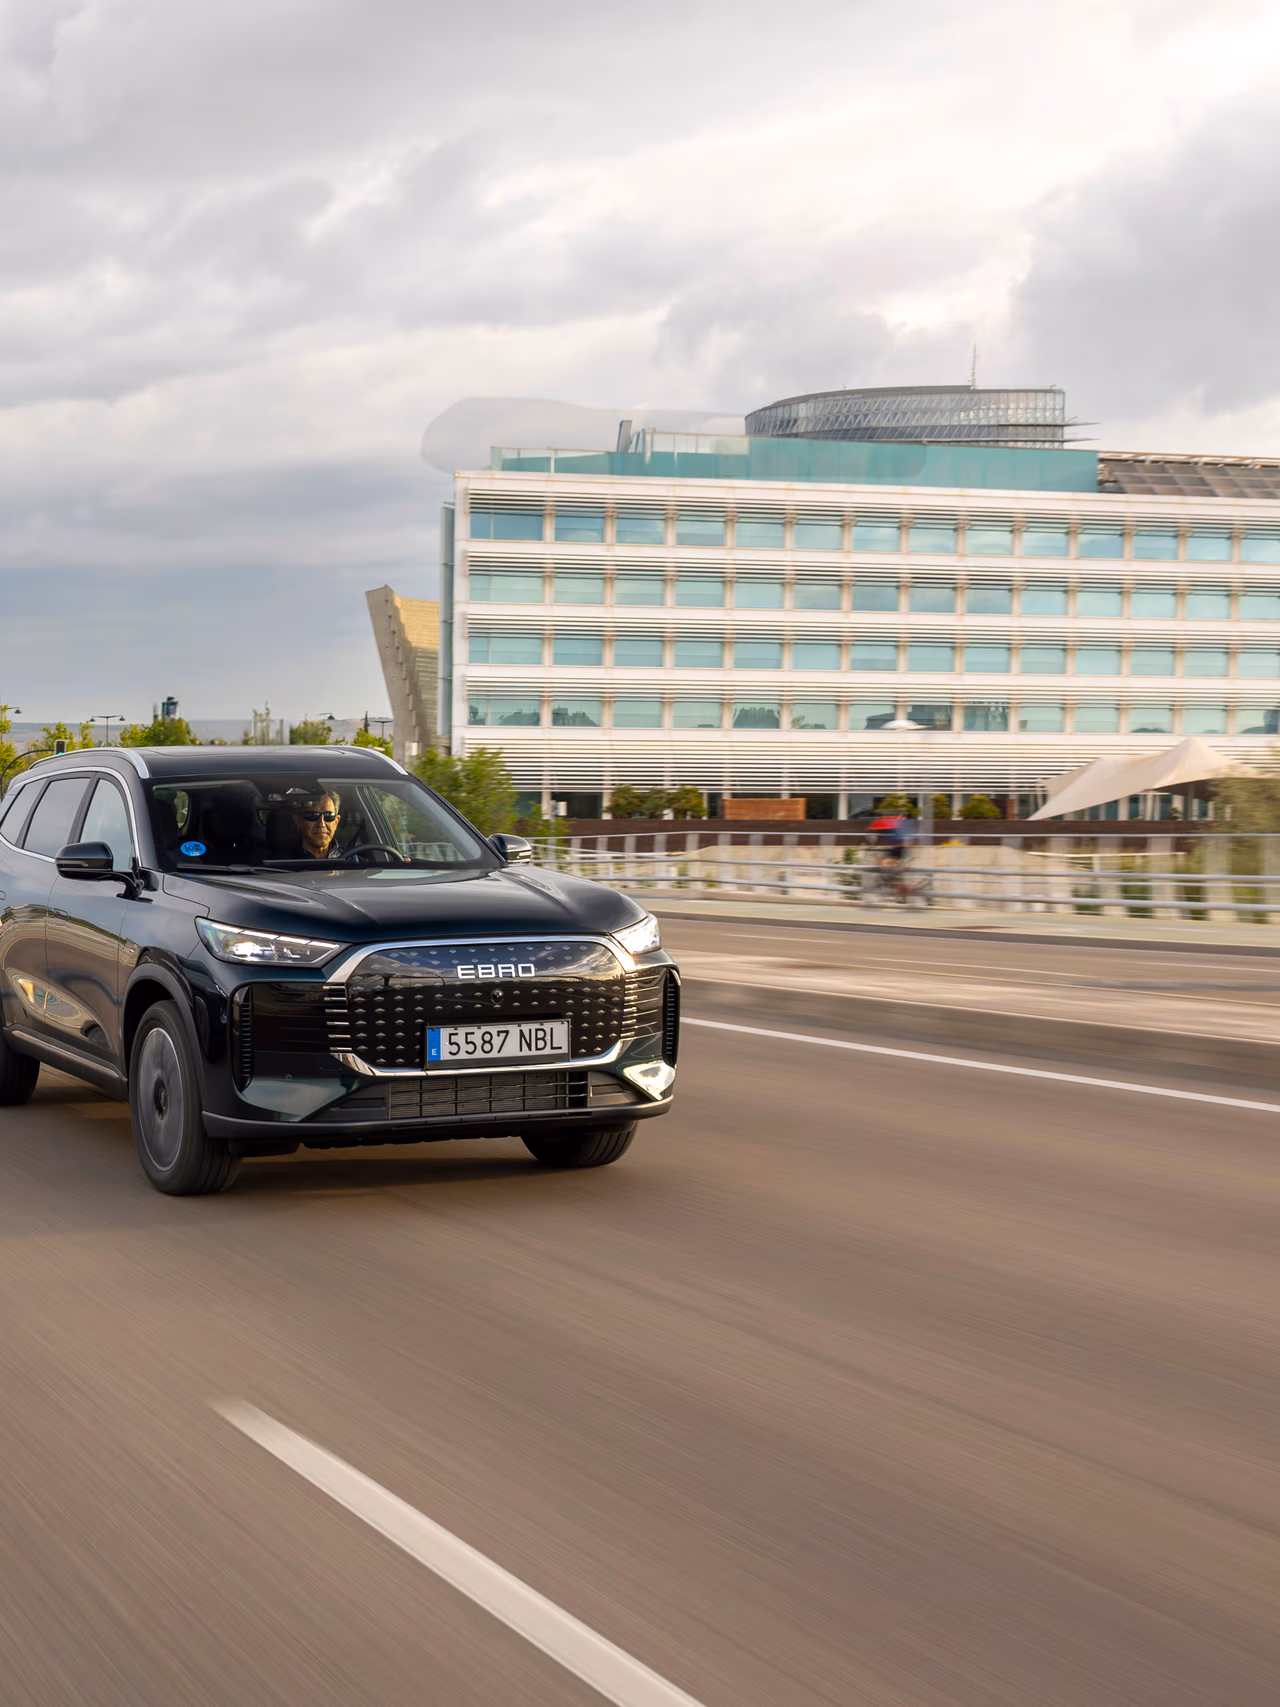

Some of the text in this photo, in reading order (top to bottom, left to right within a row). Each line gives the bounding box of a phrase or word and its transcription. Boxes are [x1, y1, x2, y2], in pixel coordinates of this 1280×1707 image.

[456, 963, 536, 979] EBRO
[431, 1027, 563, 1056] E 5587 NBL
